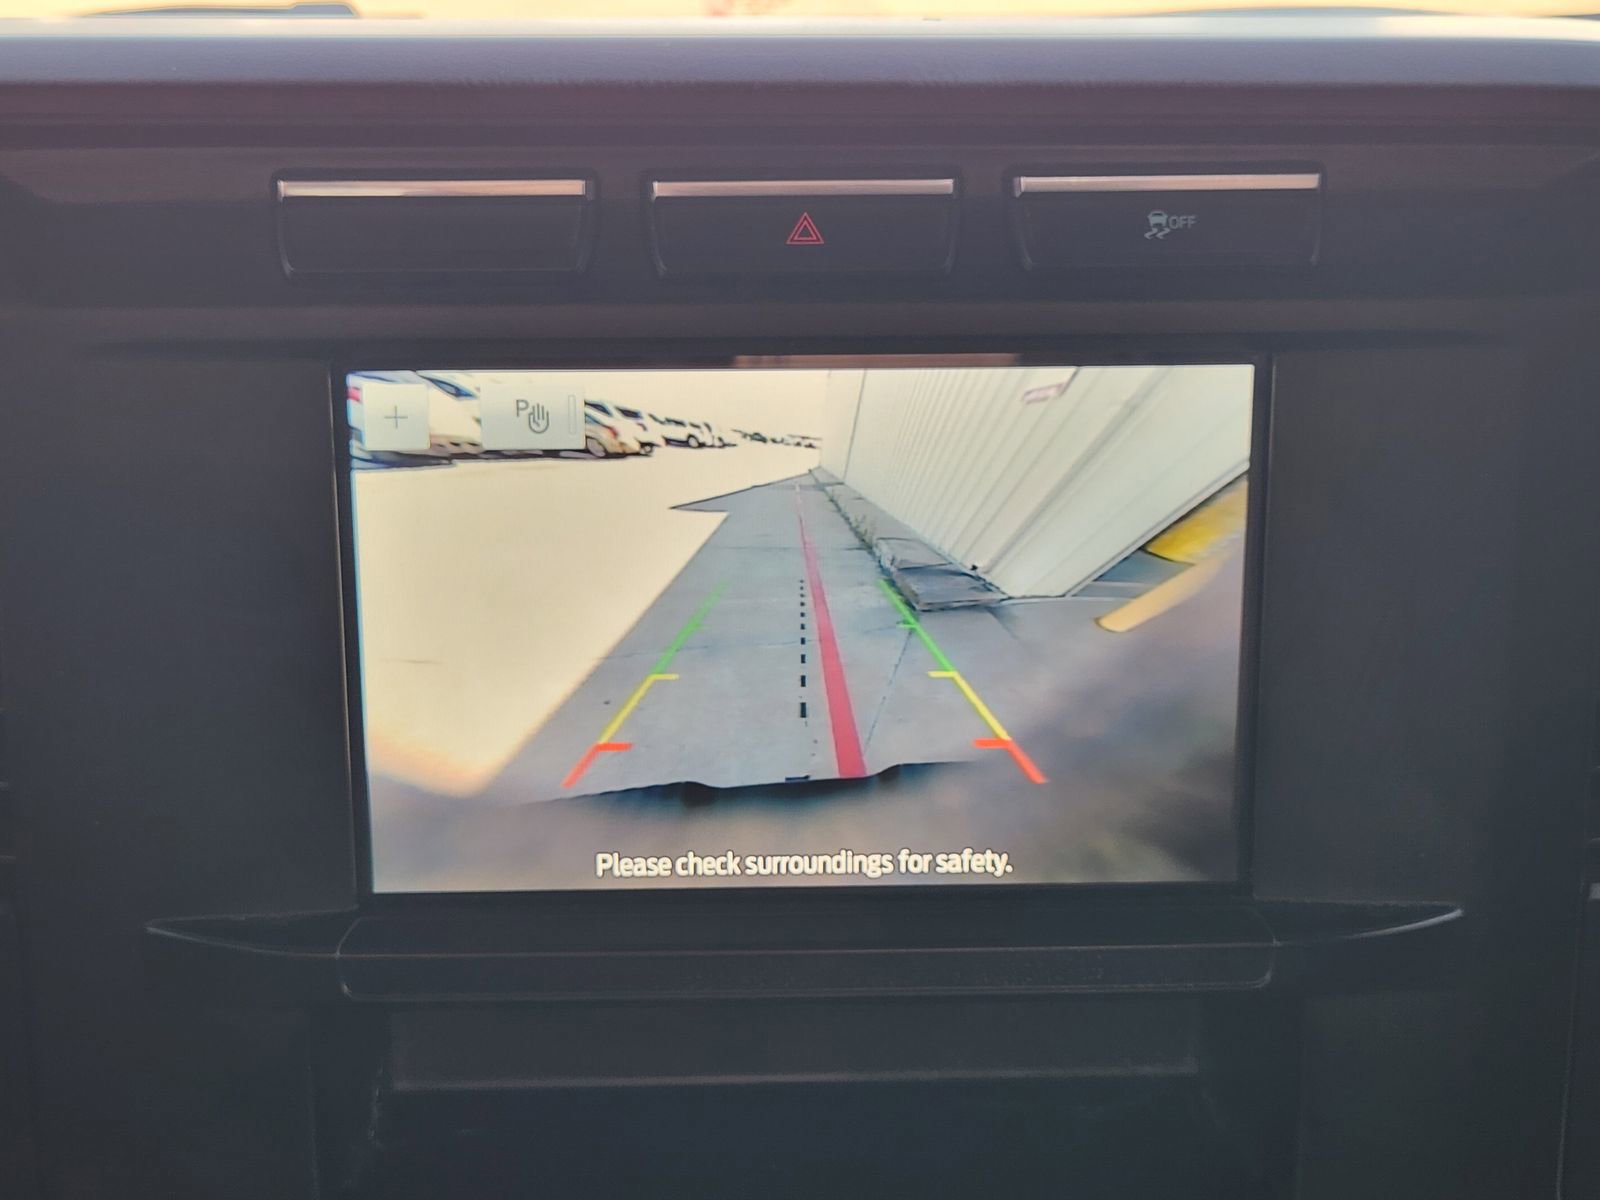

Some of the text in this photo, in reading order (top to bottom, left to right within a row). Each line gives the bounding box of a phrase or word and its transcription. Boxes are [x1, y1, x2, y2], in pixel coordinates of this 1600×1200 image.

[1168, 214, 1197, 230] OFF
[515, 399, 530, 418] P
[595, 847, 1014, 879] Please check surroundings for safety.
